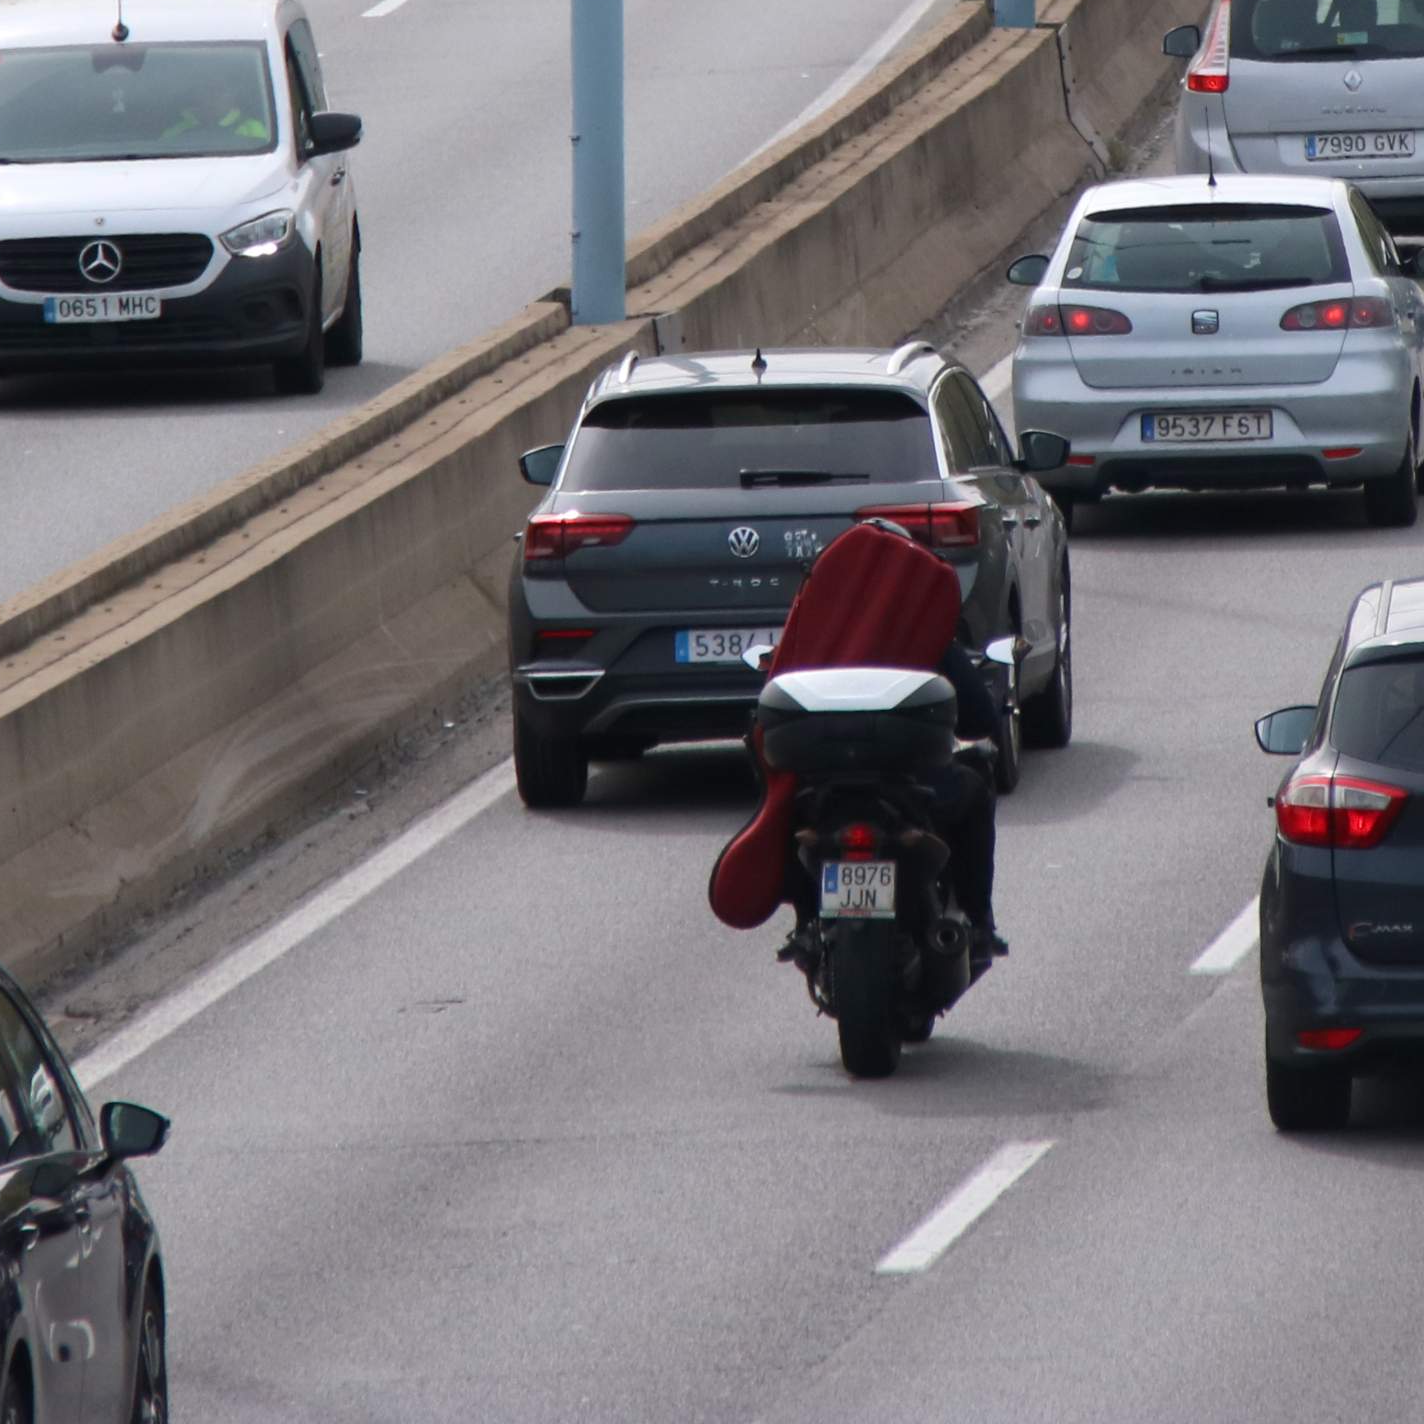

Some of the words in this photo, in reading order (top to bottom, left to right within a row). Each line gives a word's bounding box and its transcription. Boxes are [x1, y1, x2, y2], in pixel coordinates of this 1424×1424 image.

[1318, 135, 1366, 154] 7990
[1374, 134, 1409, 151] GVK
[59, 297, 108, 317] 0651
[118, 296, 156, 315] MHC
[1158, 416, 1215, 436] 9537
[842, 865, 891, 886] 8976
[840, 888, 877, 907] JJN
